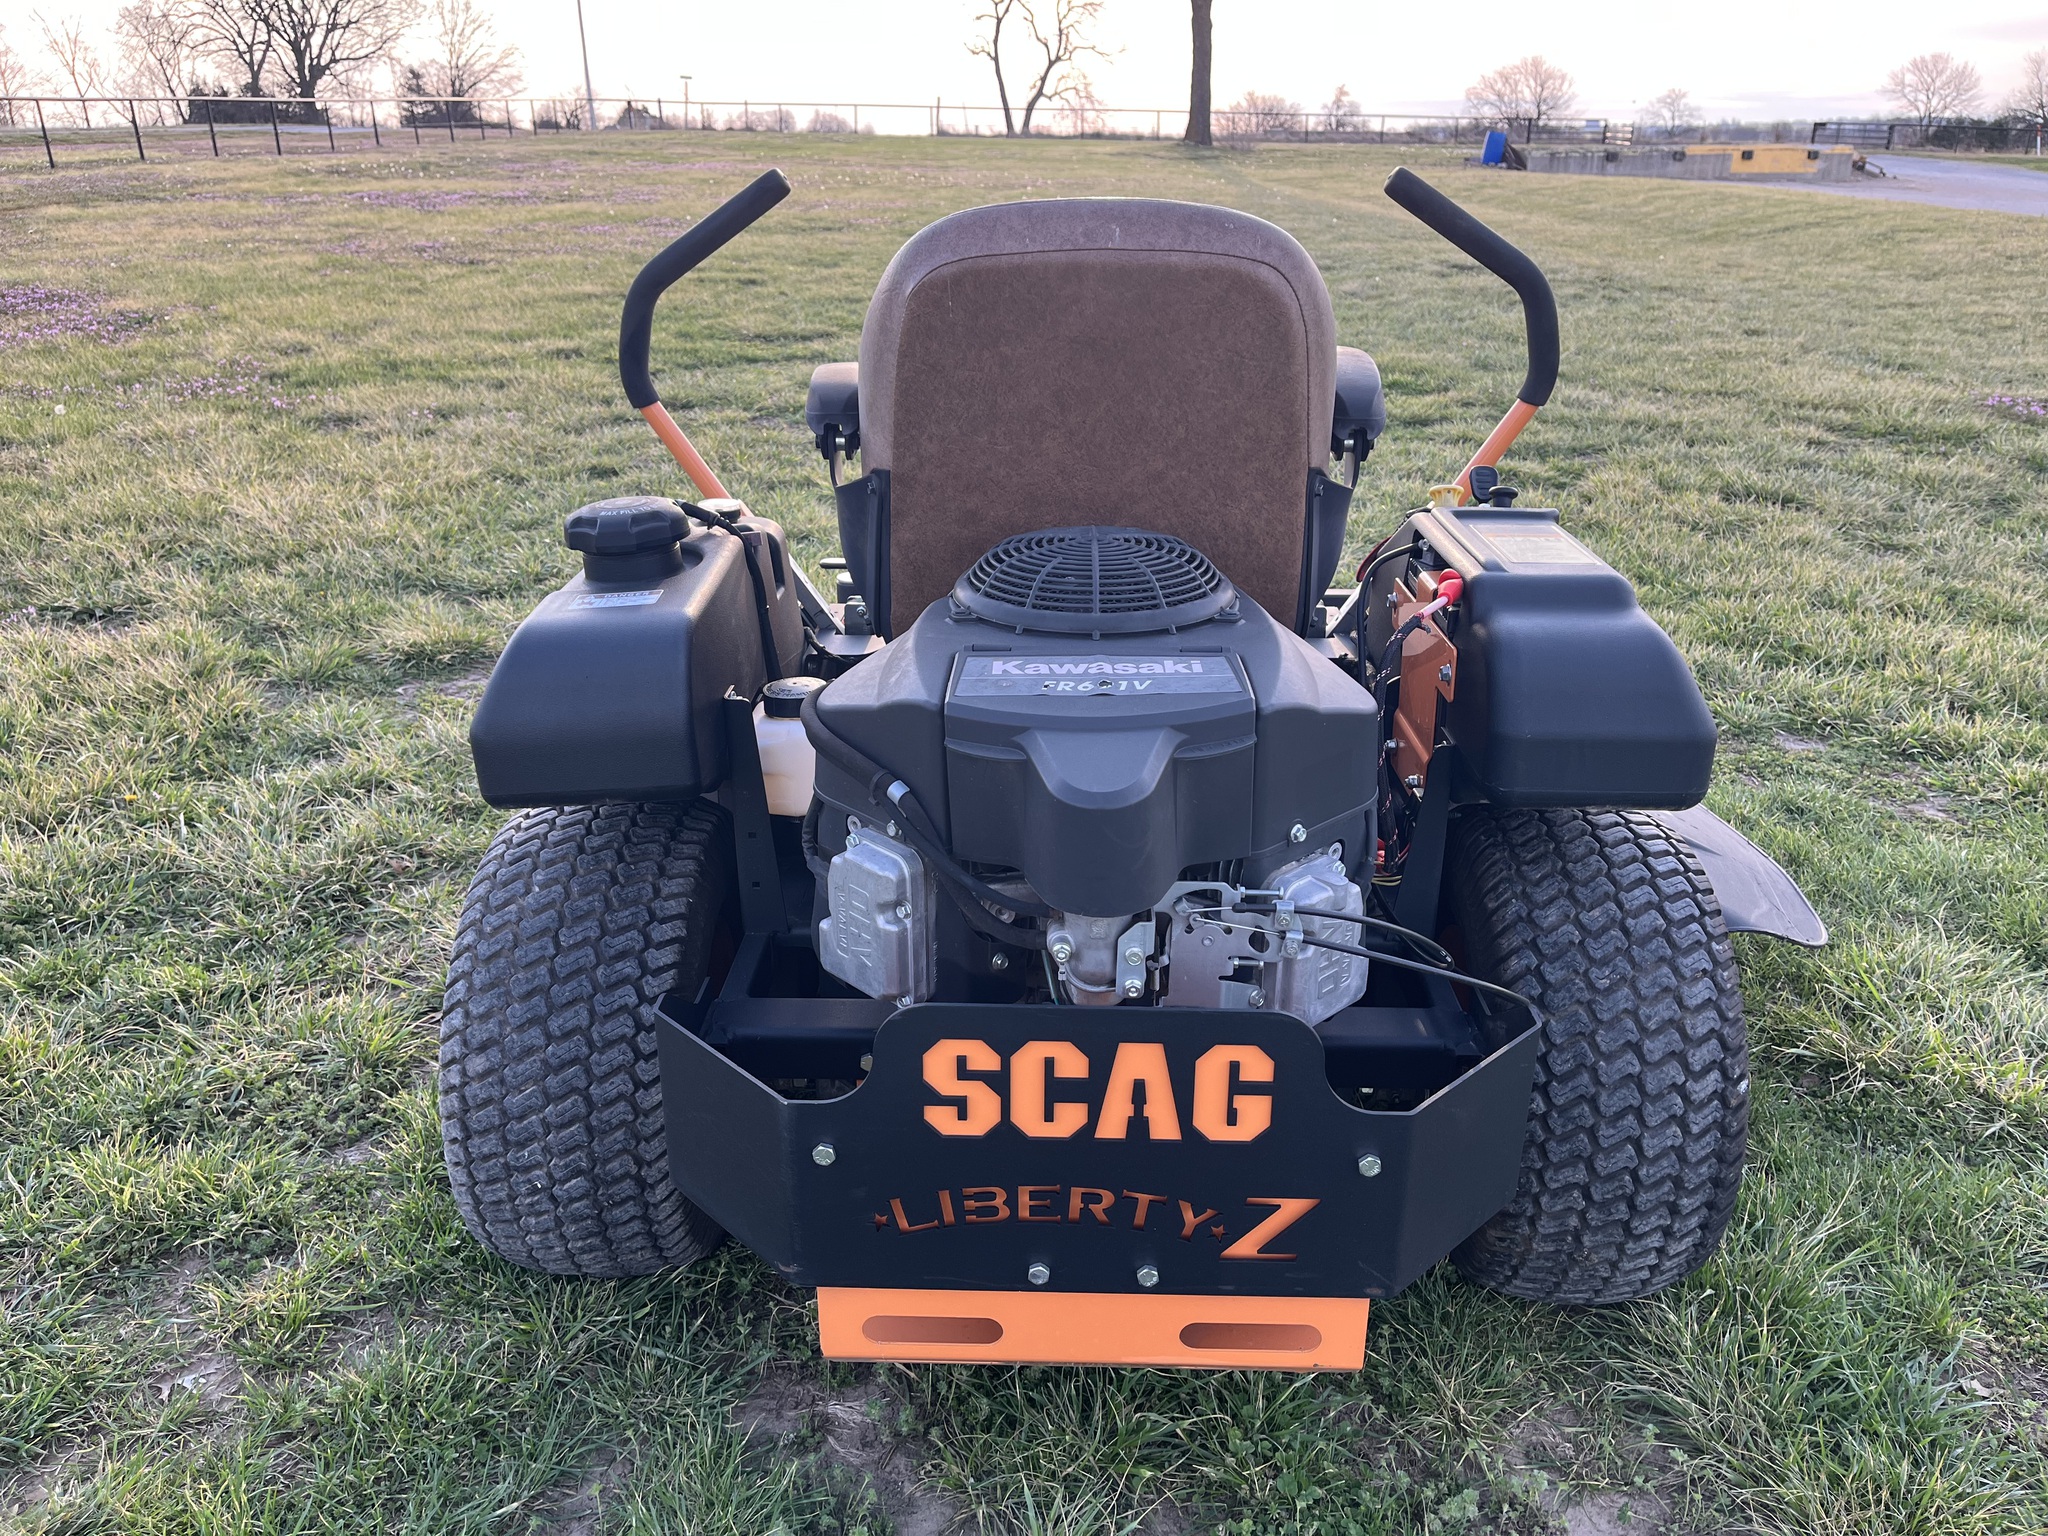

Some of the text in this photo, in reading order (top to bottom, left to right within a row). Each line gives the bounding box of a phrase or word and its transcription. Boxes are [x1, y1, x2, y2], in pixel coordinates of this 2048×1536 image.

[992, 660, 1204, 675] Kawasaki
[922, 1038, 1276, 1142] SCAG
[889, 1184, 1322, 1260] LIBERTY Z
